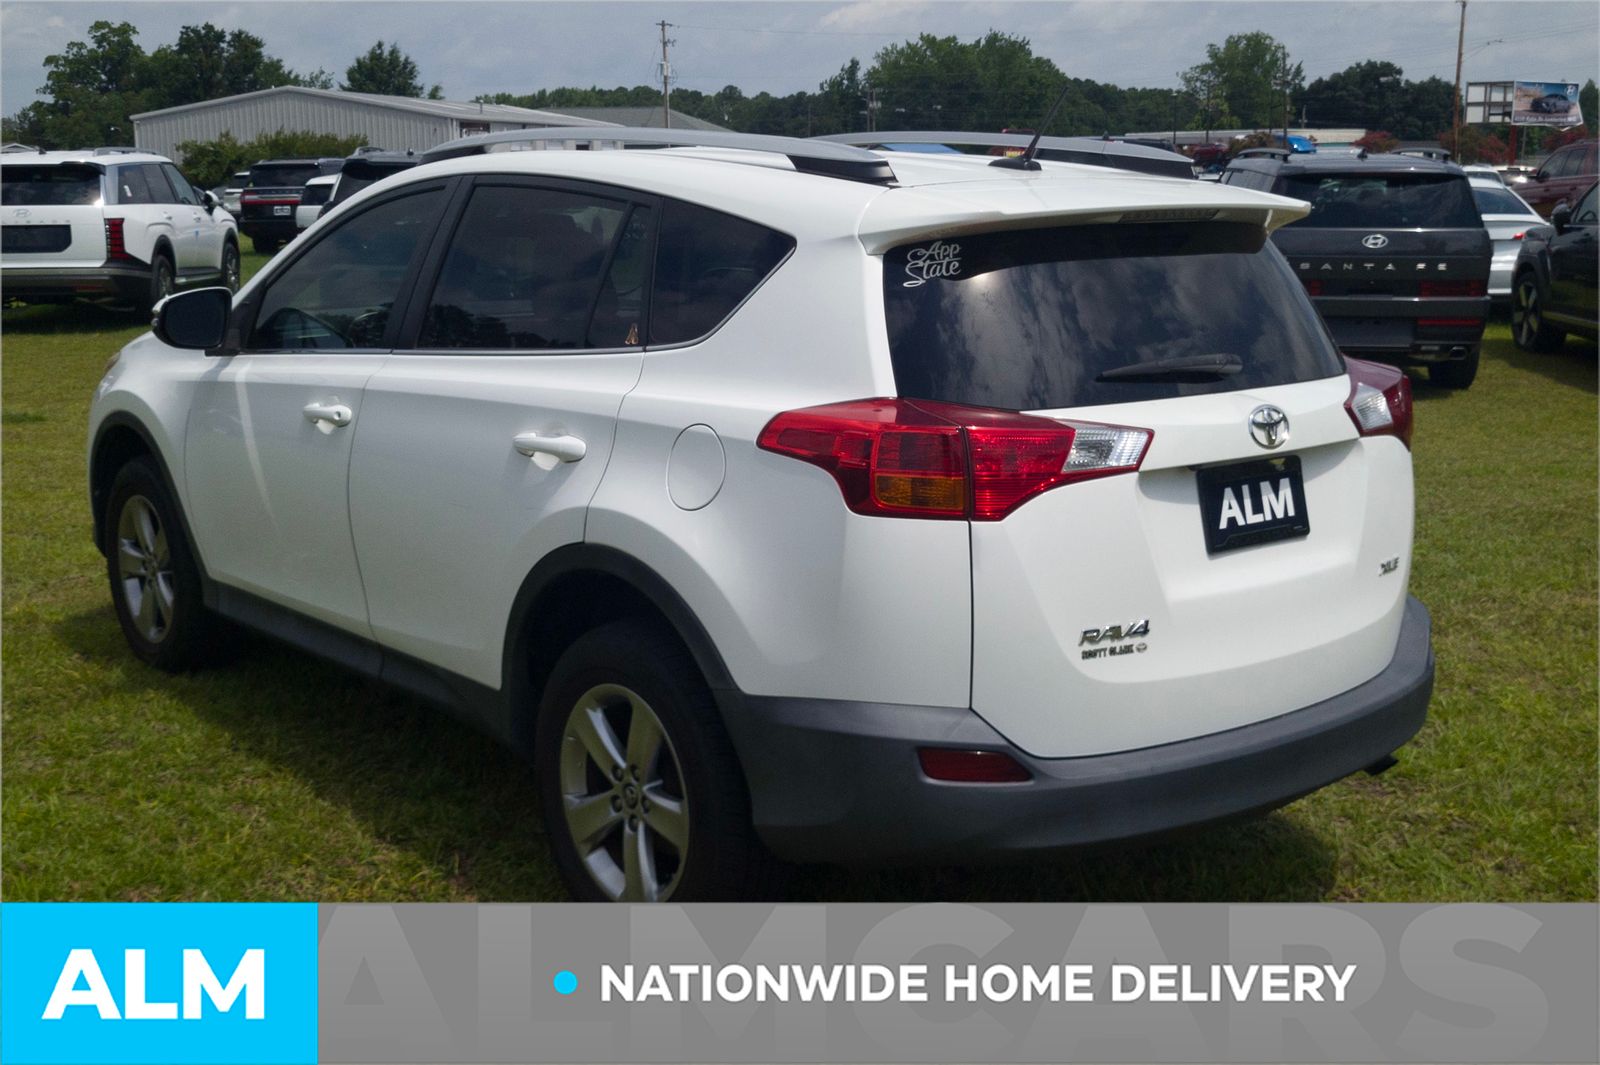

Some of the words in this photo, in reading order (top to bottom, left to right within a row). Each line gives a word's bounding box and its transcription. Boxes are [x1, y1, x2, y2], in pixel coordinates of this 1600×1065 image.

[907, 241, 961, 260] App
[903, 257, 961, 287] State
[1299, 262, 1397, 271] SANTA
[1415, 262, 1447, 271] FE
[1219, 477, 1295, 530] ALM
[1078, 619, 1150, 647] RAV4
